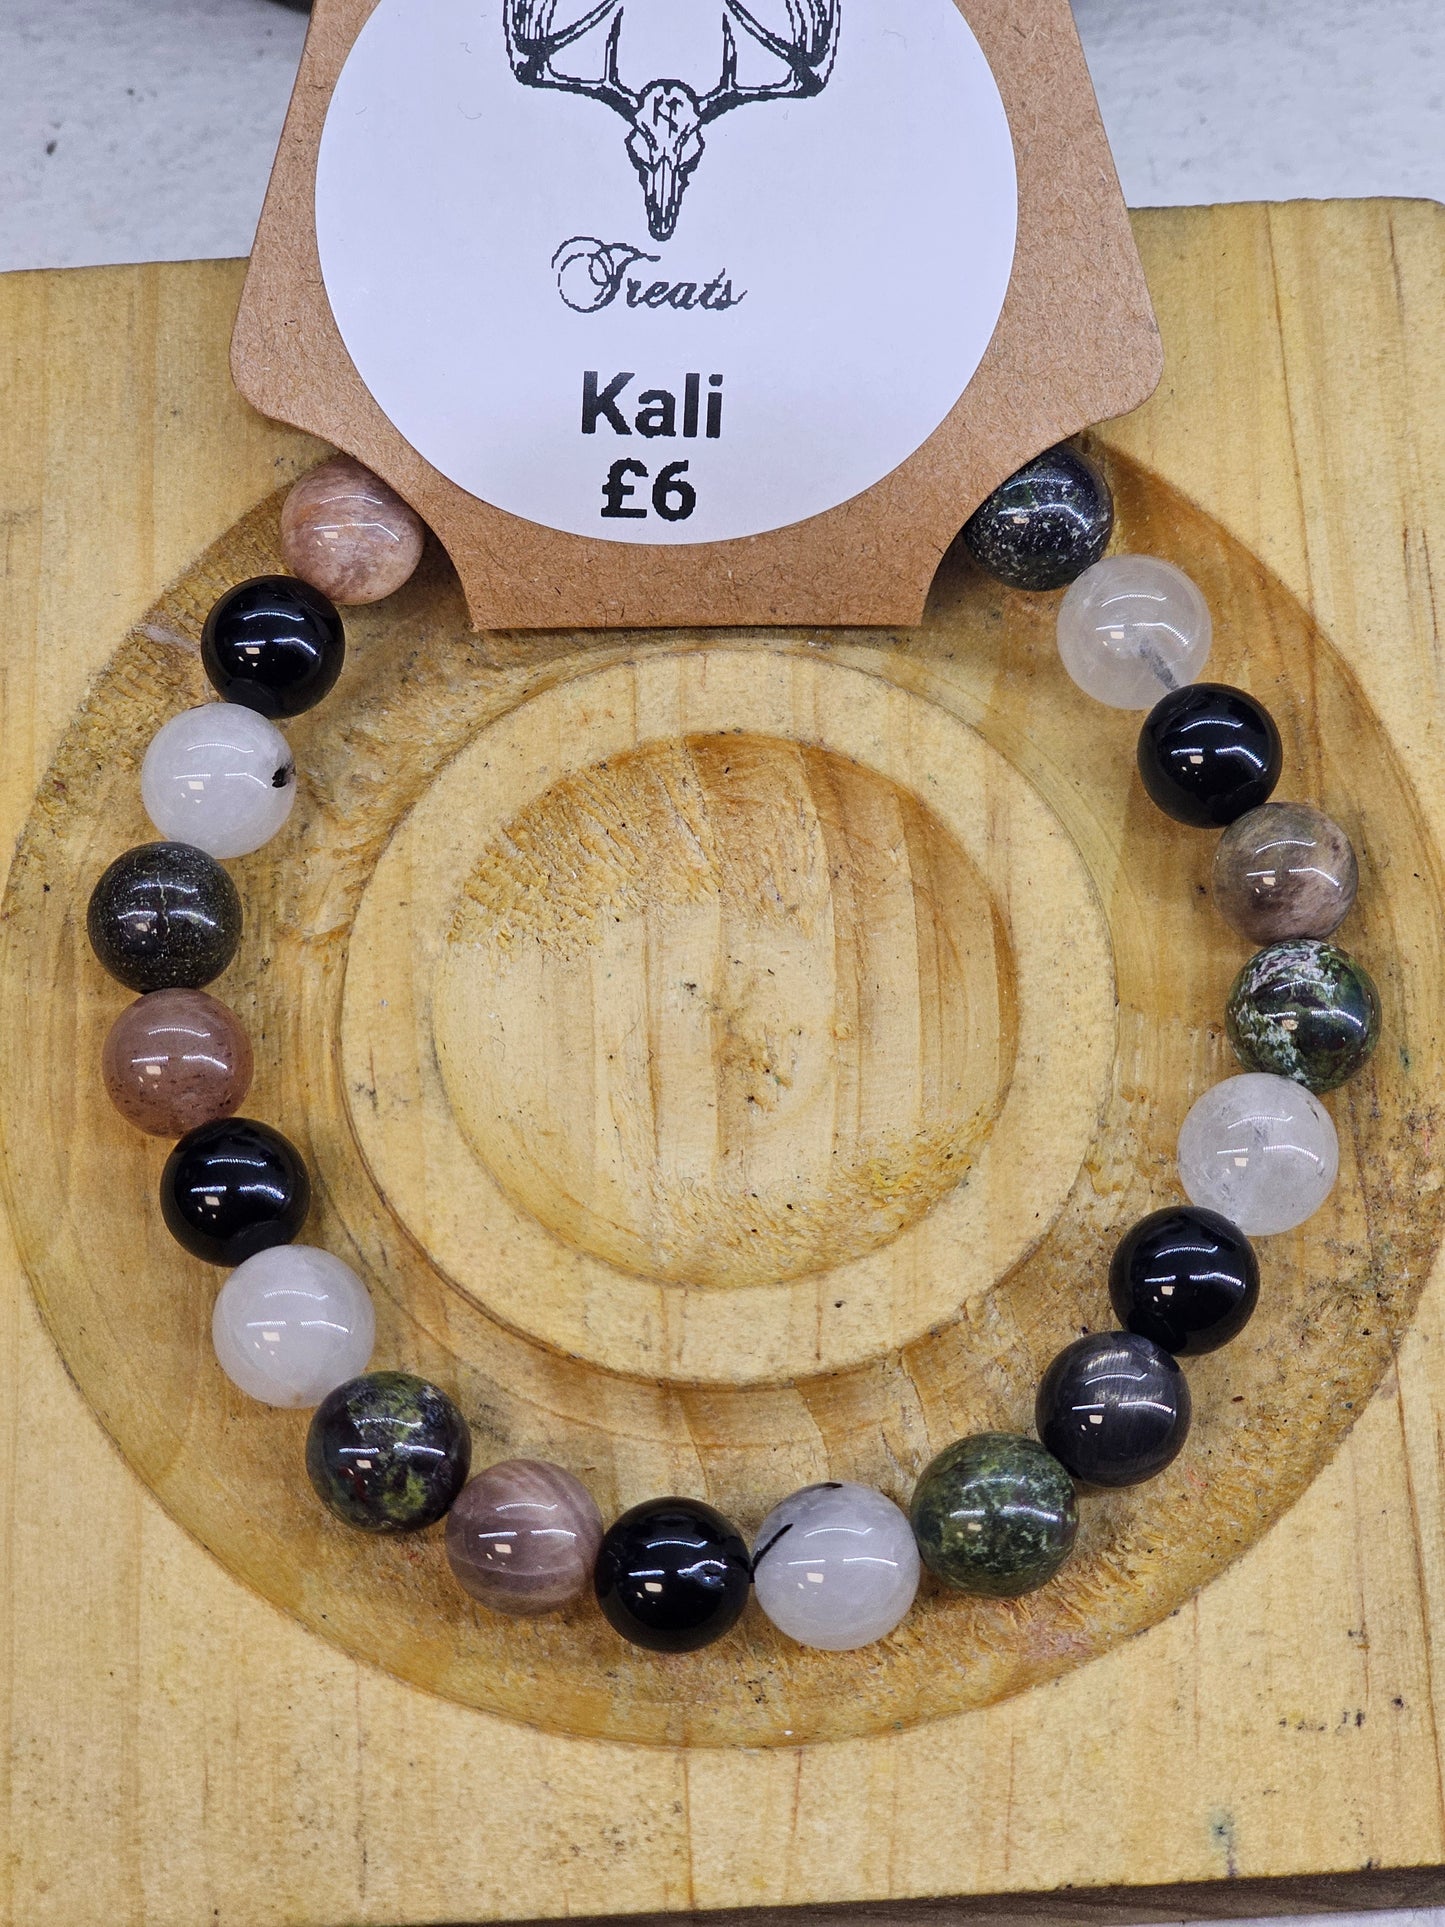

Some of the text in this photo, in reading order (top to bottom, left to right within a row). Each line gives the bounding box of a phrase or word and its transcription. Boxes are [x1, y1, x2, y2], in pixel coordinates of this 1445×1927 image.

[552, 236, 748, 313] Treats
[581, 371, 723, 438] Kali
[600, 458, 696, 521] £6
